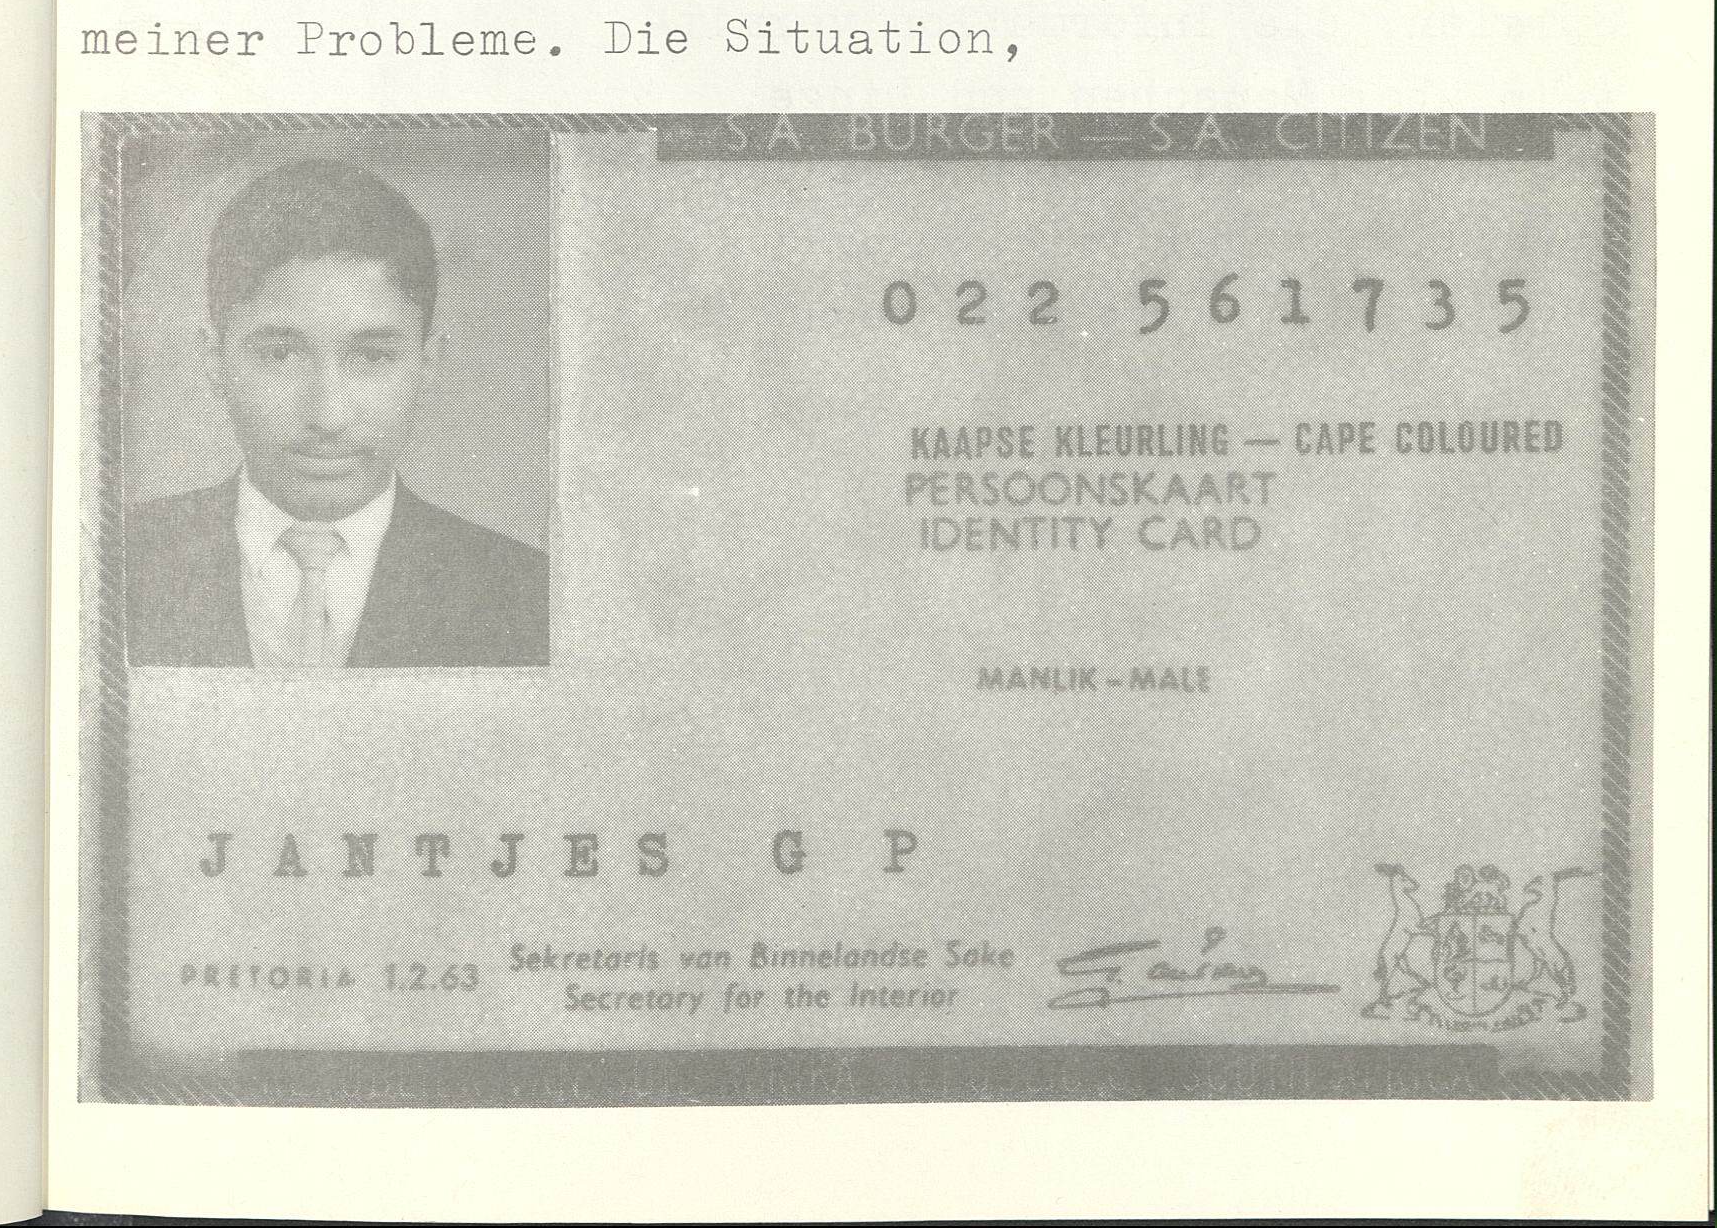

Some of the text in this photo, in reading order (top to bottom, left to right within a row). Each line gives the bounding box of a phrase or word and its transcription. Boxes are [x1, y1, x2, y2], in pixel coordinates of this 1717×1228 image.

[81, 30, 263, 56] meiner
[298, 22, 561, 56] Probleme.
[605, 21, 687, 54] Die
[727, 19, 1017, 62] Situation,
[849, 113, 1060, 152] BURGER
[1275, 113, 1487, 152] CITIZEN
[883, 272, 1531, 334] 022 561735
[910, 425, 1036, 460] KAAPSE
[1054, 423, 1230, 459] KLEURLING
[1294, 420, 1377, 457] CAPE
[1394, 419, 1564, 455] COLOURED
[904, 470, 1277, 507] PERSOONSKAART
[919, 515, 1262, 552] IDENTITY CARD
[199, 828, 920, 879] JANTJES G P
[509, 939, 1017, 972] Sekretaris van Binnelandse Sake
[179, 961, 481, 991] PRETORIA 1.2.63
[563, 981, 961, 1016] Secretary for the Interior
